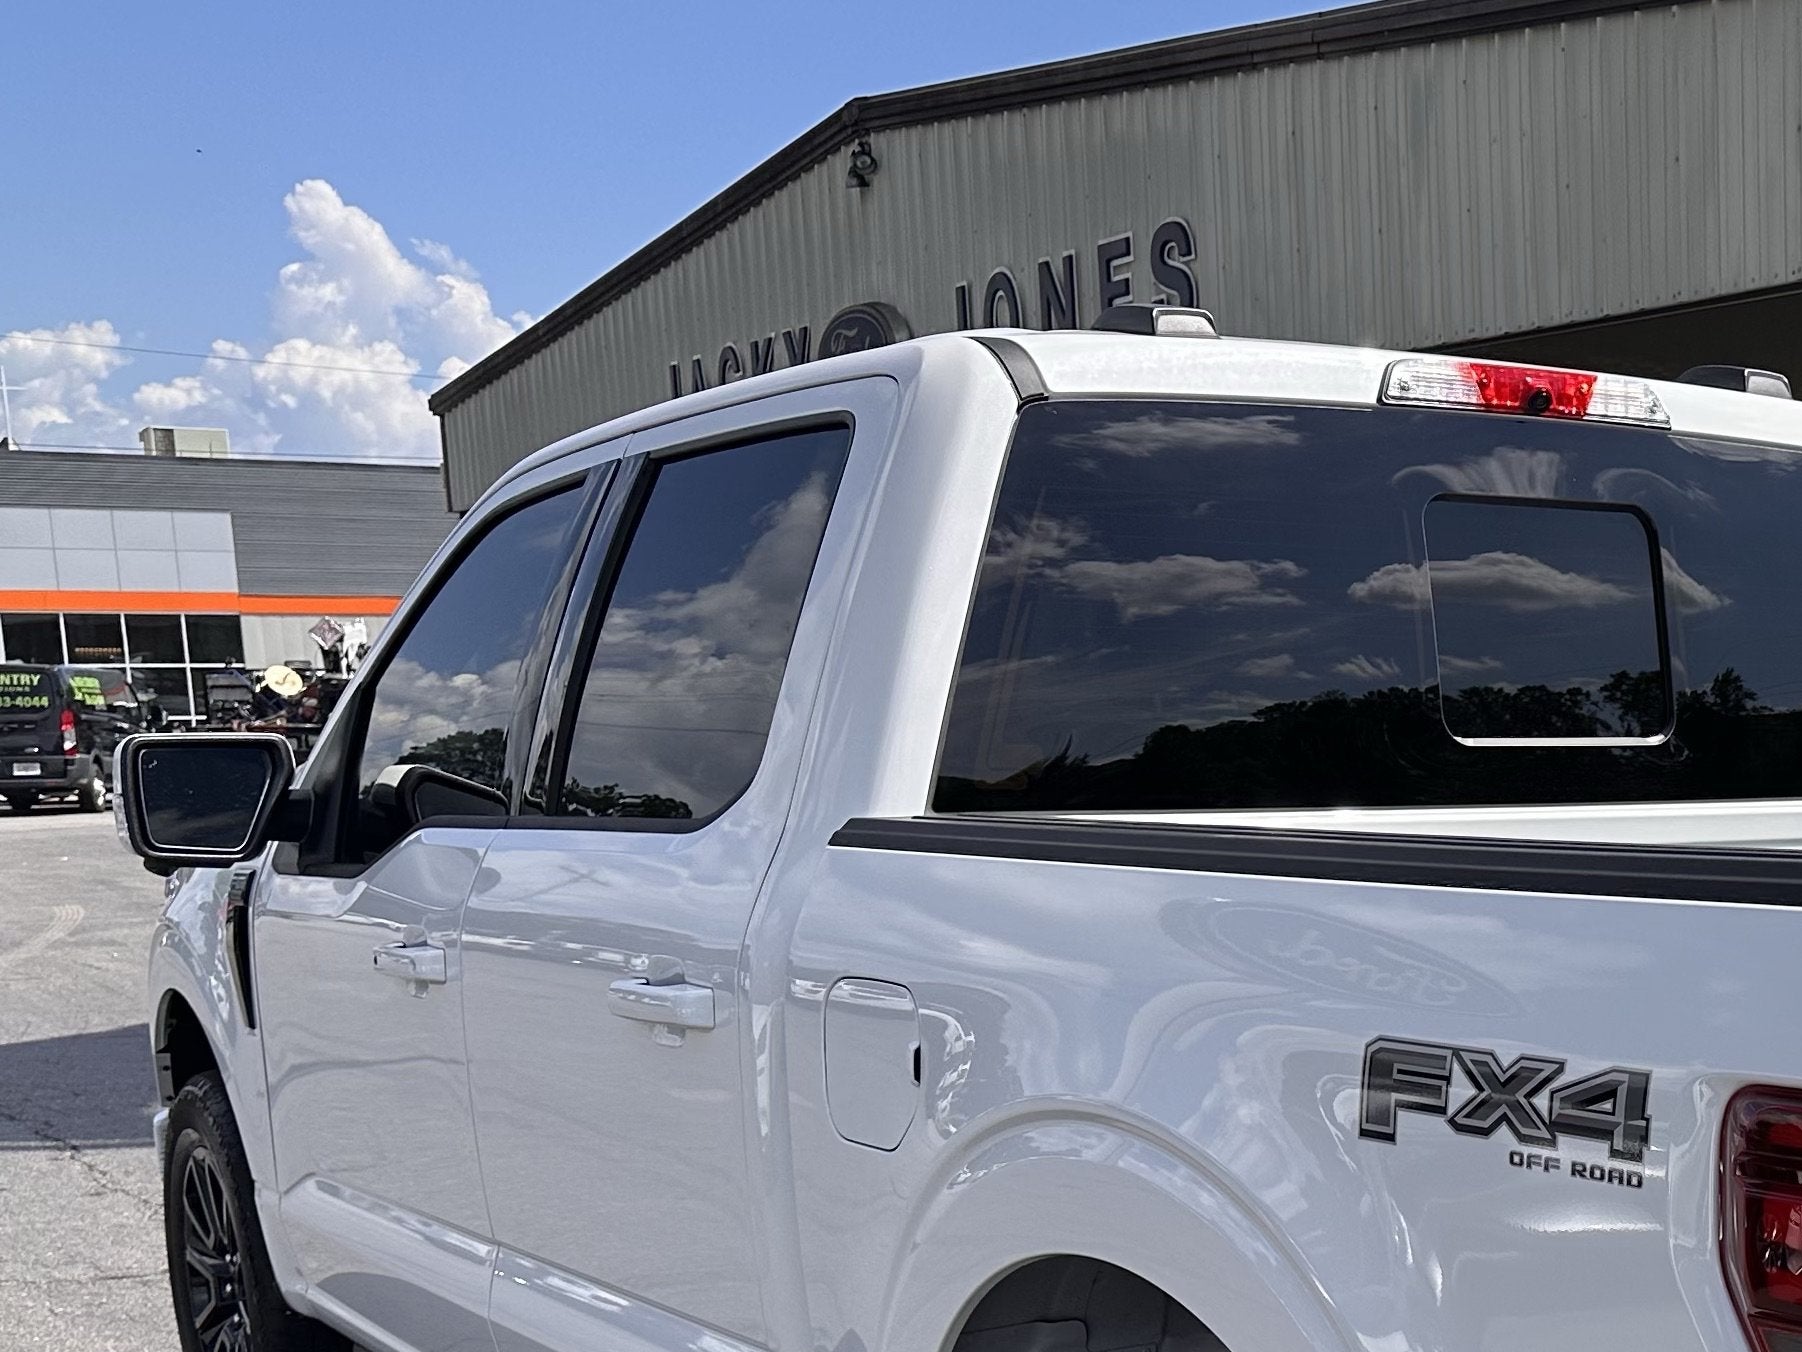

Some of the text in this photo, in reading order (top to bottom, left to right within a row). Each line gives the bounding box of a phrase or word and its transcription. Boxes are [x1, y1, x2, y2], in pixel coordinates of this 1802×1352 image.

[1358, 1034, 1652, 1166] FX4
[1508, 1150, 1643, 1189] OFF ROAD
